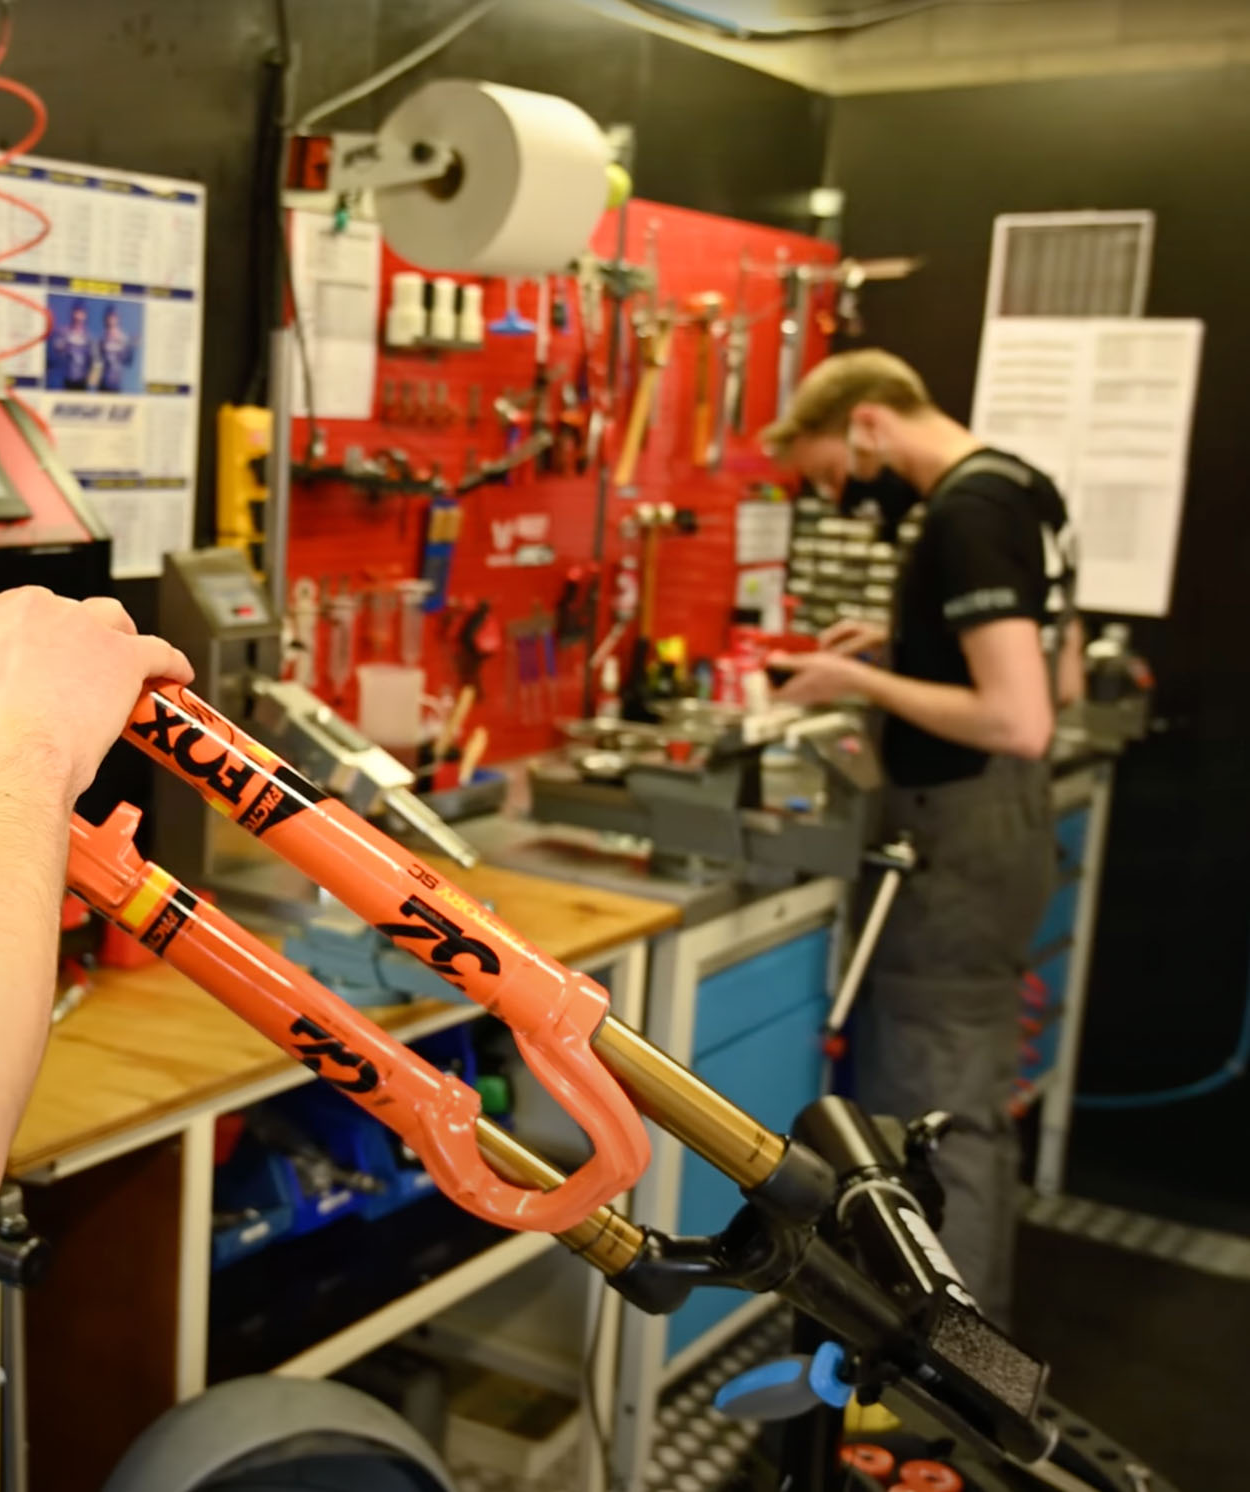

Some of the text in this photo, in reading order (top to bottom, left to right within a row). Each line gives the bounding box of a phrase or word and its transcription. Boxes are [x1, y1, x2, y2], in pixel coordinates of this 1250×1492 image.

[129, 689, 264, 804] FOX
[407, 863, 440, 890] SC
[375, 893, 501, 991] 32
